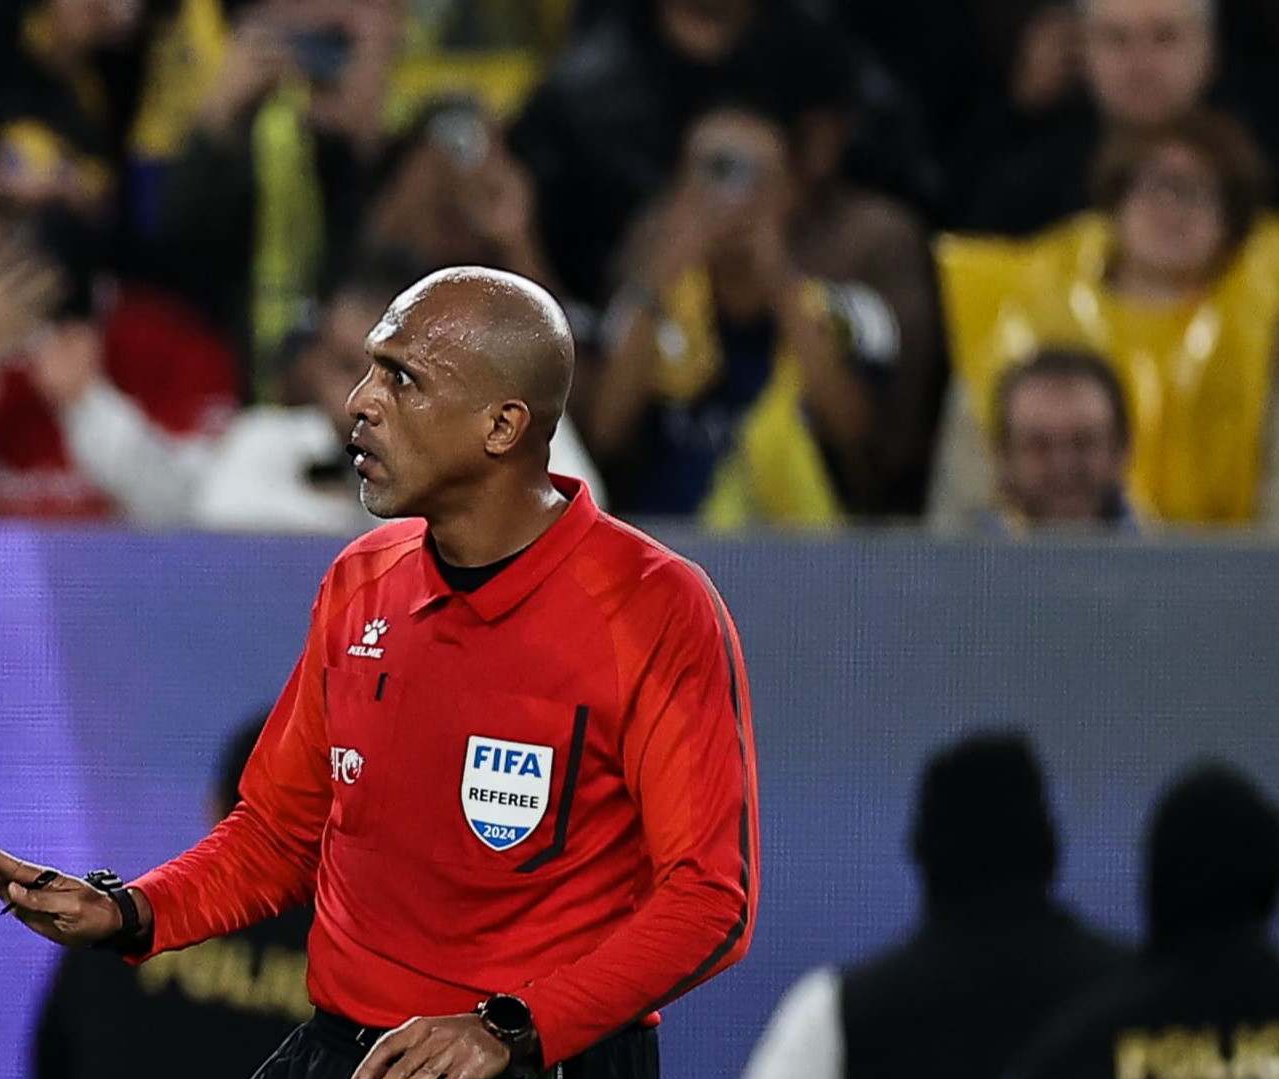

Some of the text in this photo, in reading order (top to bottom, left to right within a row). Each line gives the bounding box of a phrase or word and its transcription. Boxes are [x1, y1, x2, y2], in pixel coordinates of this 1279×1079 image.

[347, 645, 384, 658] KELME
[473, 745, 542, 778] FIFA
[469, 787, 539, 809] REFEREE
[483, 825, 516, 841] 2024
